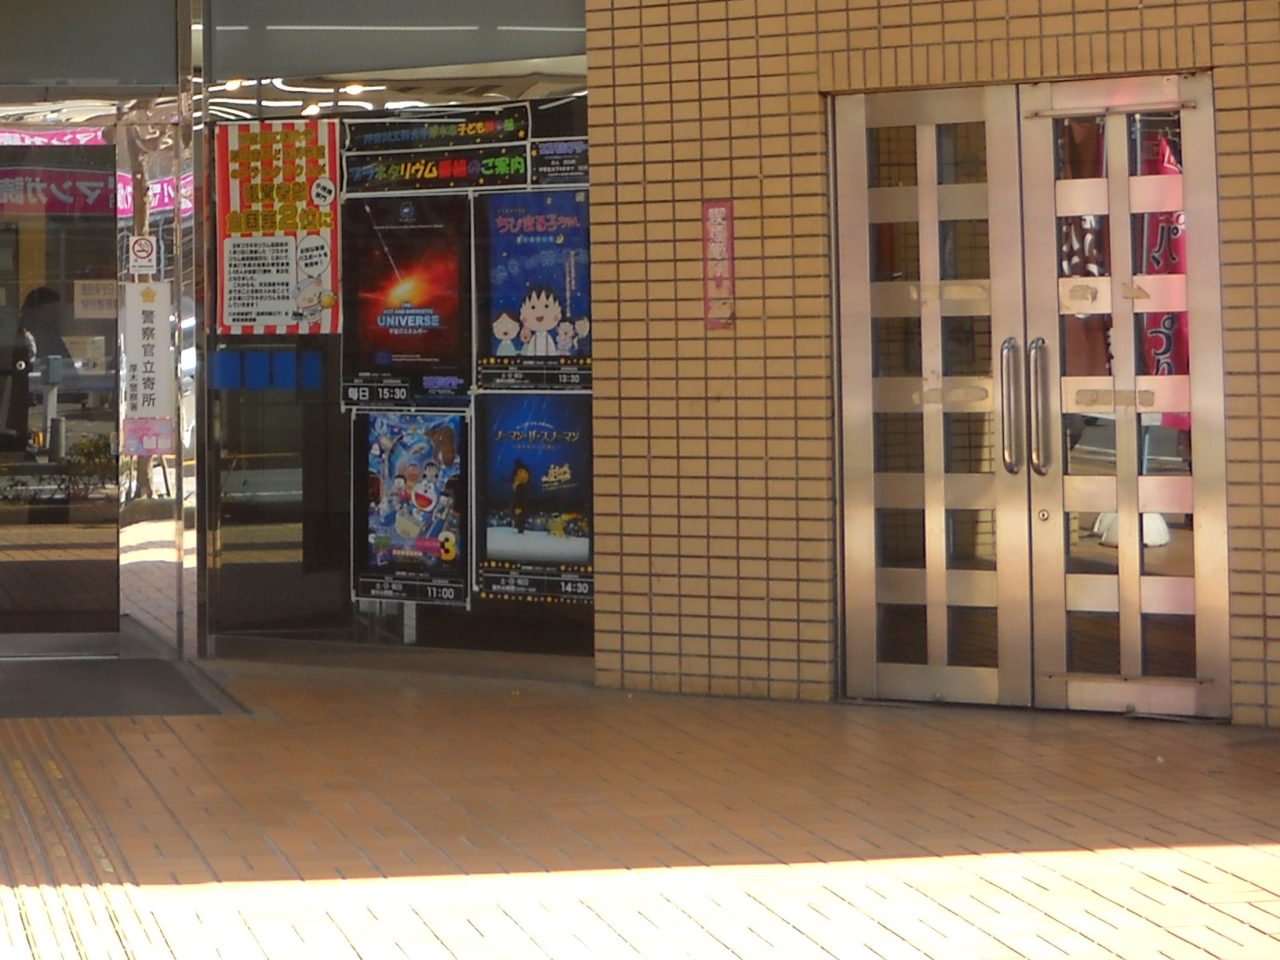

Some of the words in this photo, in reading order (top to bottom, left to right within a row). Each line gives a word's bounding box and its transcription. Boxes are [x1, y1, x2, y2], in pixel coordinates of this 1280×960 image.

[496, 213, 582, 233] ちびまる子ちゃん
[377, 315, 440, 327] UNIVERSE
[141, 309, 156, 408] 警察官立寄所
[558, 374, 580, 383] 13:30
[348, 387, 369, 400] 毎日
[377, 388, 407, 400] 15:30
[426, 586, 455, 599] 11:00
[559, 581, 589, 593] 14:30
